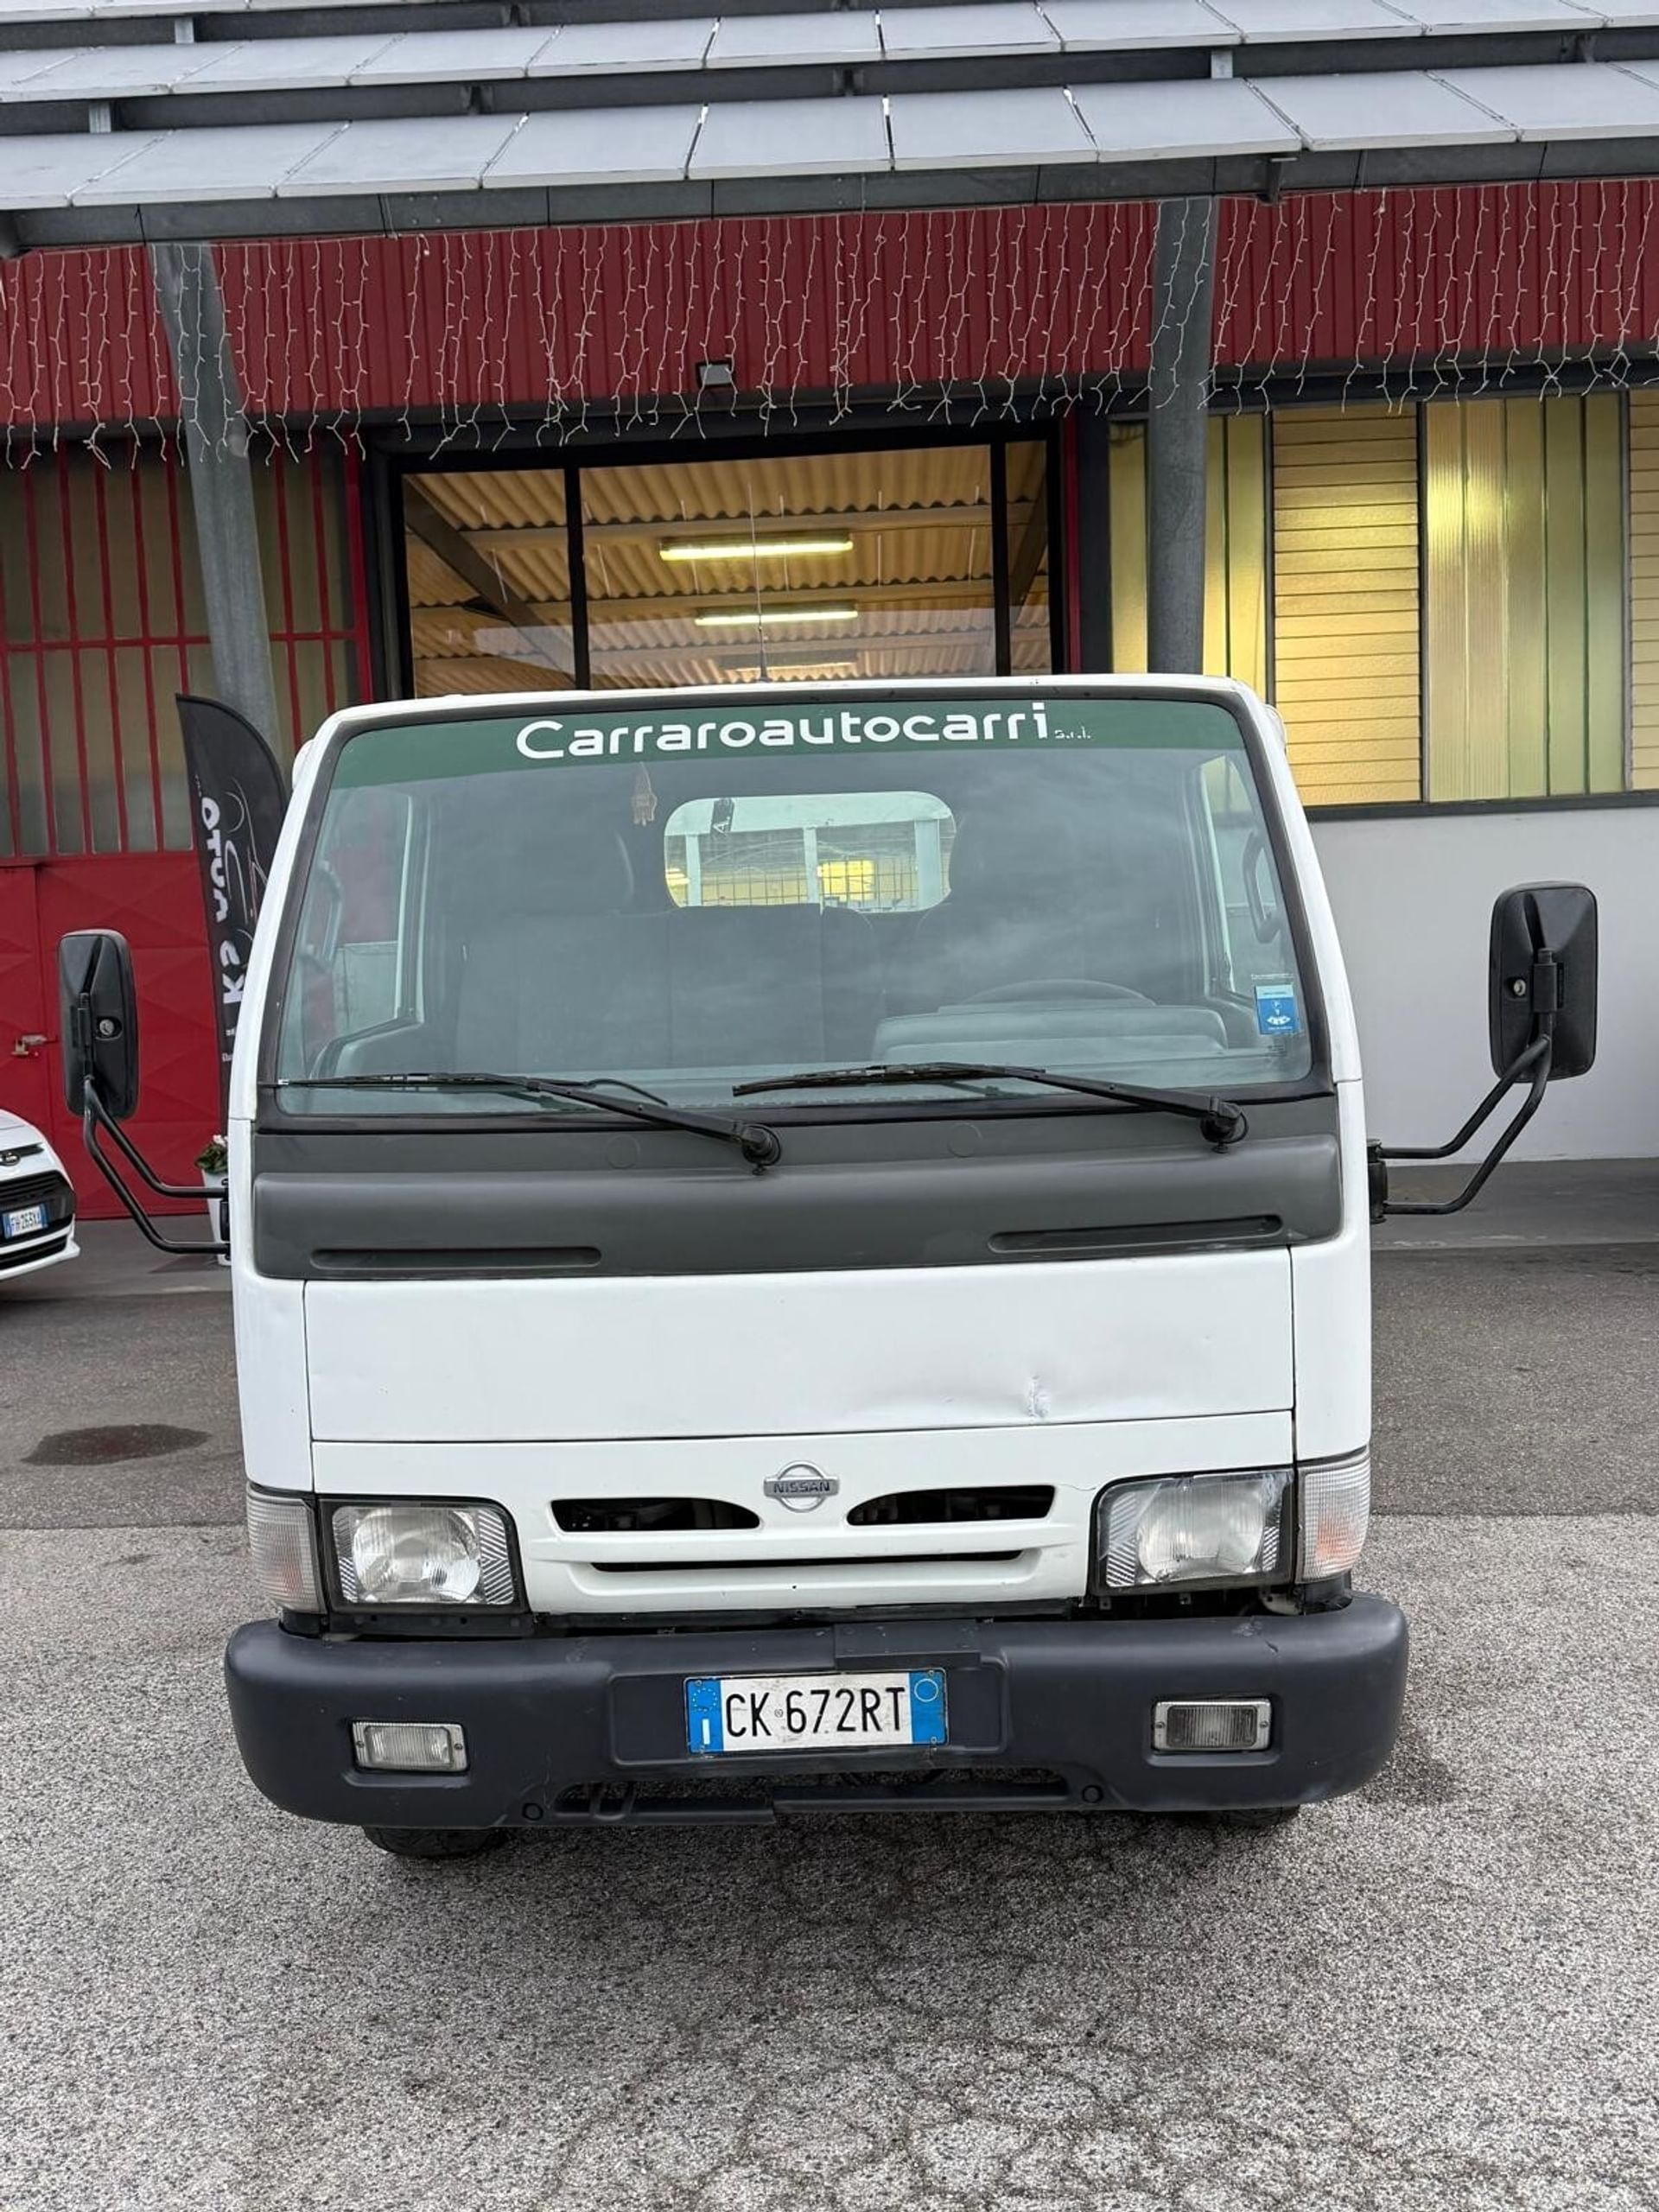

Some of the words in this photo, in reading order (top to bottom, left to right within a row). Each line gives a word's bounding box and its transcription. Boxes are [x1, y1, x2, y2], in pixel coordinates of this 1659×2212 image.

[516, 702, 1049, 760] Carraroautocarri
[773, 1481, 830, 1494] NISSAN
[725, 1691, 772, 1738] CK
[785, 1686, 906, 1734] 672RT
